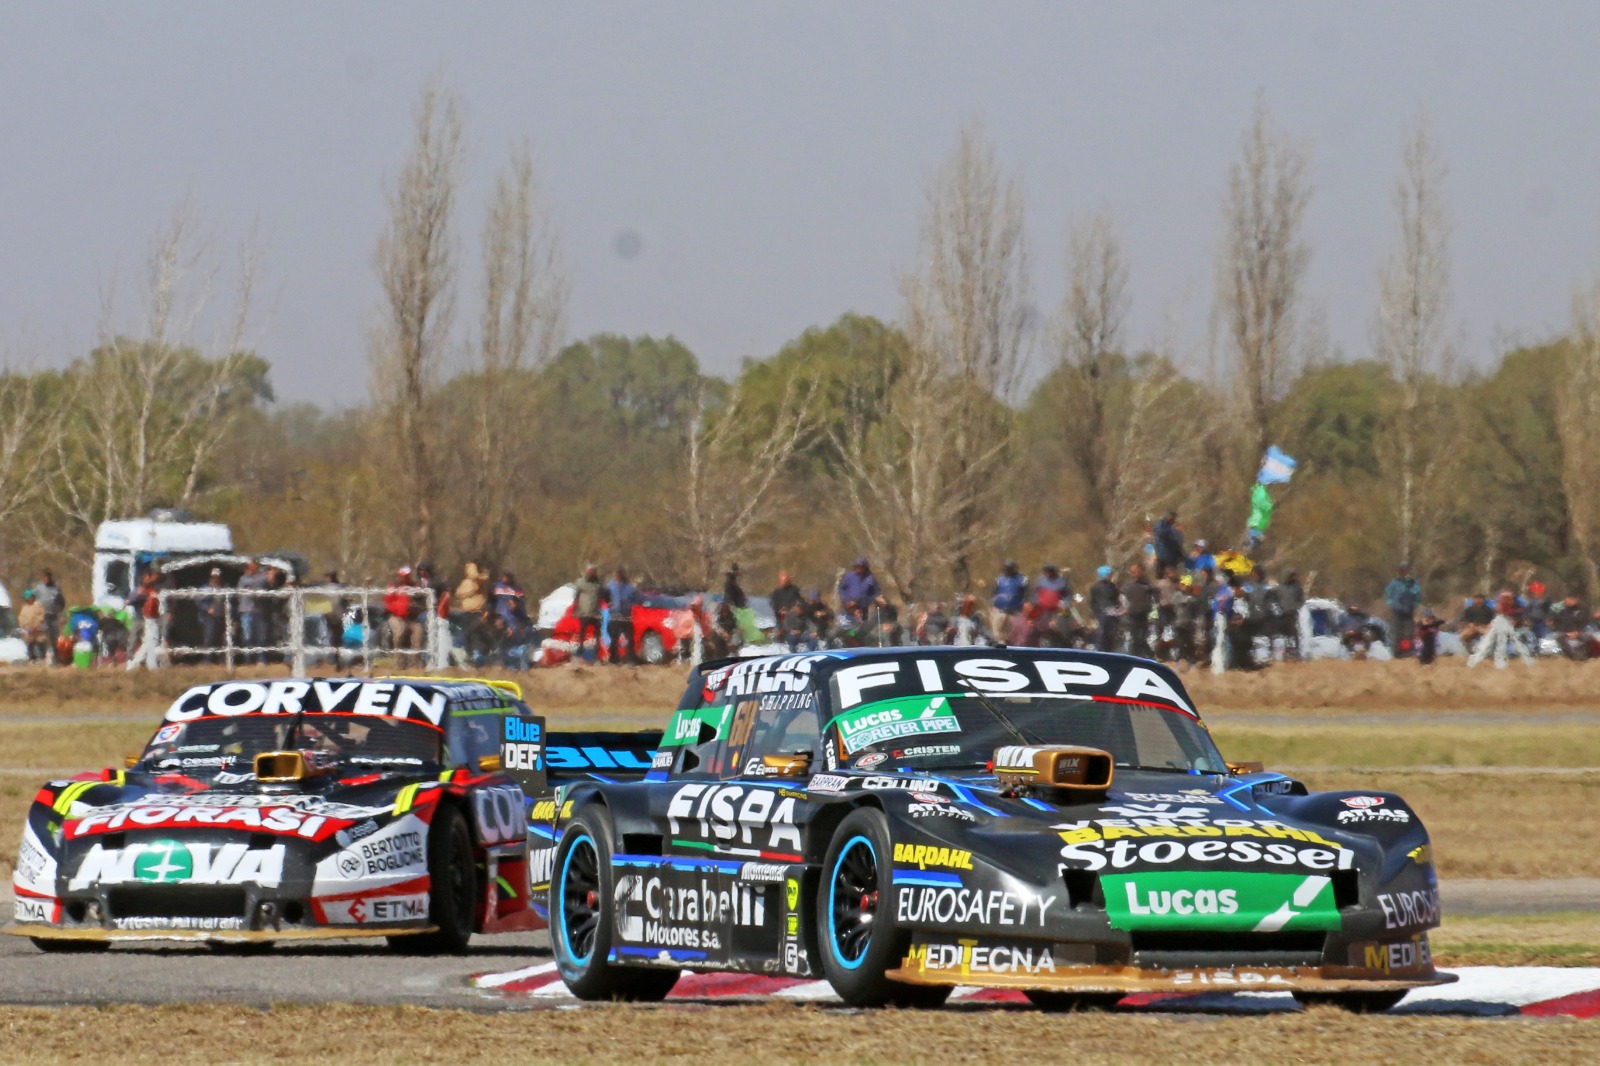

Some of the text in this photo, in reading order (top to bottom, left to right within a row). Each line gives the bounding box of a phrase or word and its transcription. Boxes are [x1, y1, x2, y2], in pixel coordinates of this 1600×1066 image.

[725, 656, 827, 695] ATLAS
[836, 659, 1198, 716] FISPA
[165, 681, 447, 726] CORVEN
[759, 693, 812, 711] SHIPPING
[505, 716, 540, 742] Blue
[675, 713, 701, 740] Lucas
[842, 709, 903, 735] Lucas
[848, 718, 955, 750] FOREVER PIPE
[505, 743, 539, 770] DEF
[904, 745, 960, 756] CRISTEM
[997, 745, 1043, 767] WIX
[862, 777, 939, 792] COLLINO
[74, 805, 327, 838] FIORASI
[667, 783, 801, 851] FISPA
[908, 803, 975, 818] ATLAS
[912, 811, 975, 822] SHIPPING
[1337, 809, 1410, 820] ATLAS
[1342, 815, 1409, 825] SHIPPING
[362, 831, 420, 858] BERTOTTO
[1058, 825, 1343, 848] BARDAHL
[367, 848, 424, 874] BOGLIONE
[894, 843, 973, 870] BARDAHL
[1060, 839, 1354, 871] Stoessel
[373, 899, 424, 918] ETMA
[645, 877, 765, 926] Carabelli
[897, 887, 1056, 926] EUROSAFETY
[1124, 881, 1239, 914] Lucas
[646, 921, 700, 947] Motores
[907, 939, 1056, 976] MEDITECNA
